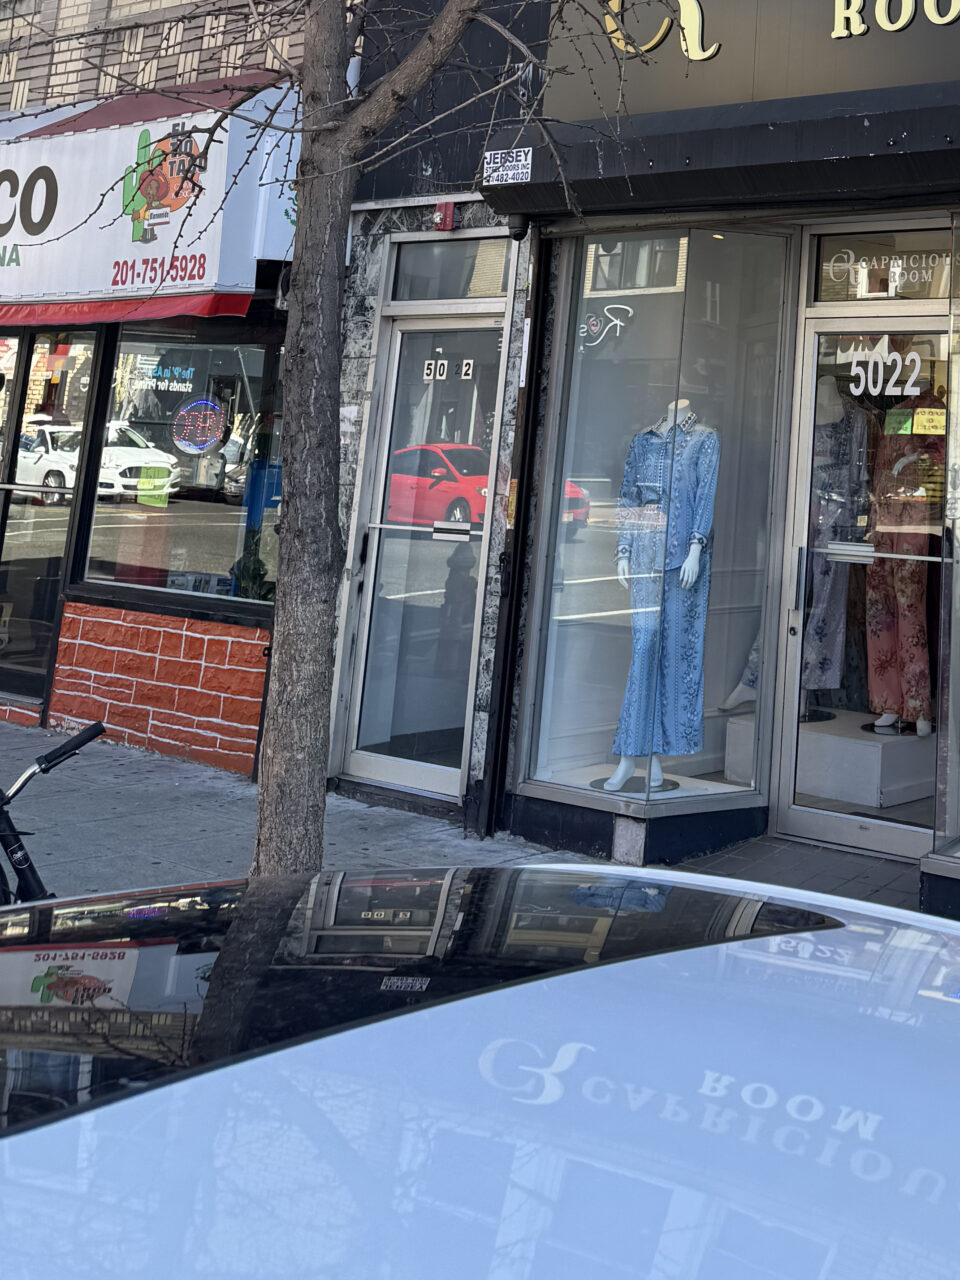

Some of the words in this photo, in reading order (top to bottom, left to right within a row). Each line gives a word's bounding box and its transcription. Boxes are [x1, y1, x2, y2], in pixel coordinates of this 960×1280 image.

[485, 149, 531, 166] JERSEY
[502, 163, 520, 173] DOORS
[888, 269, 934, 284] ROOM
[850, 351, 921, 397] 5022
